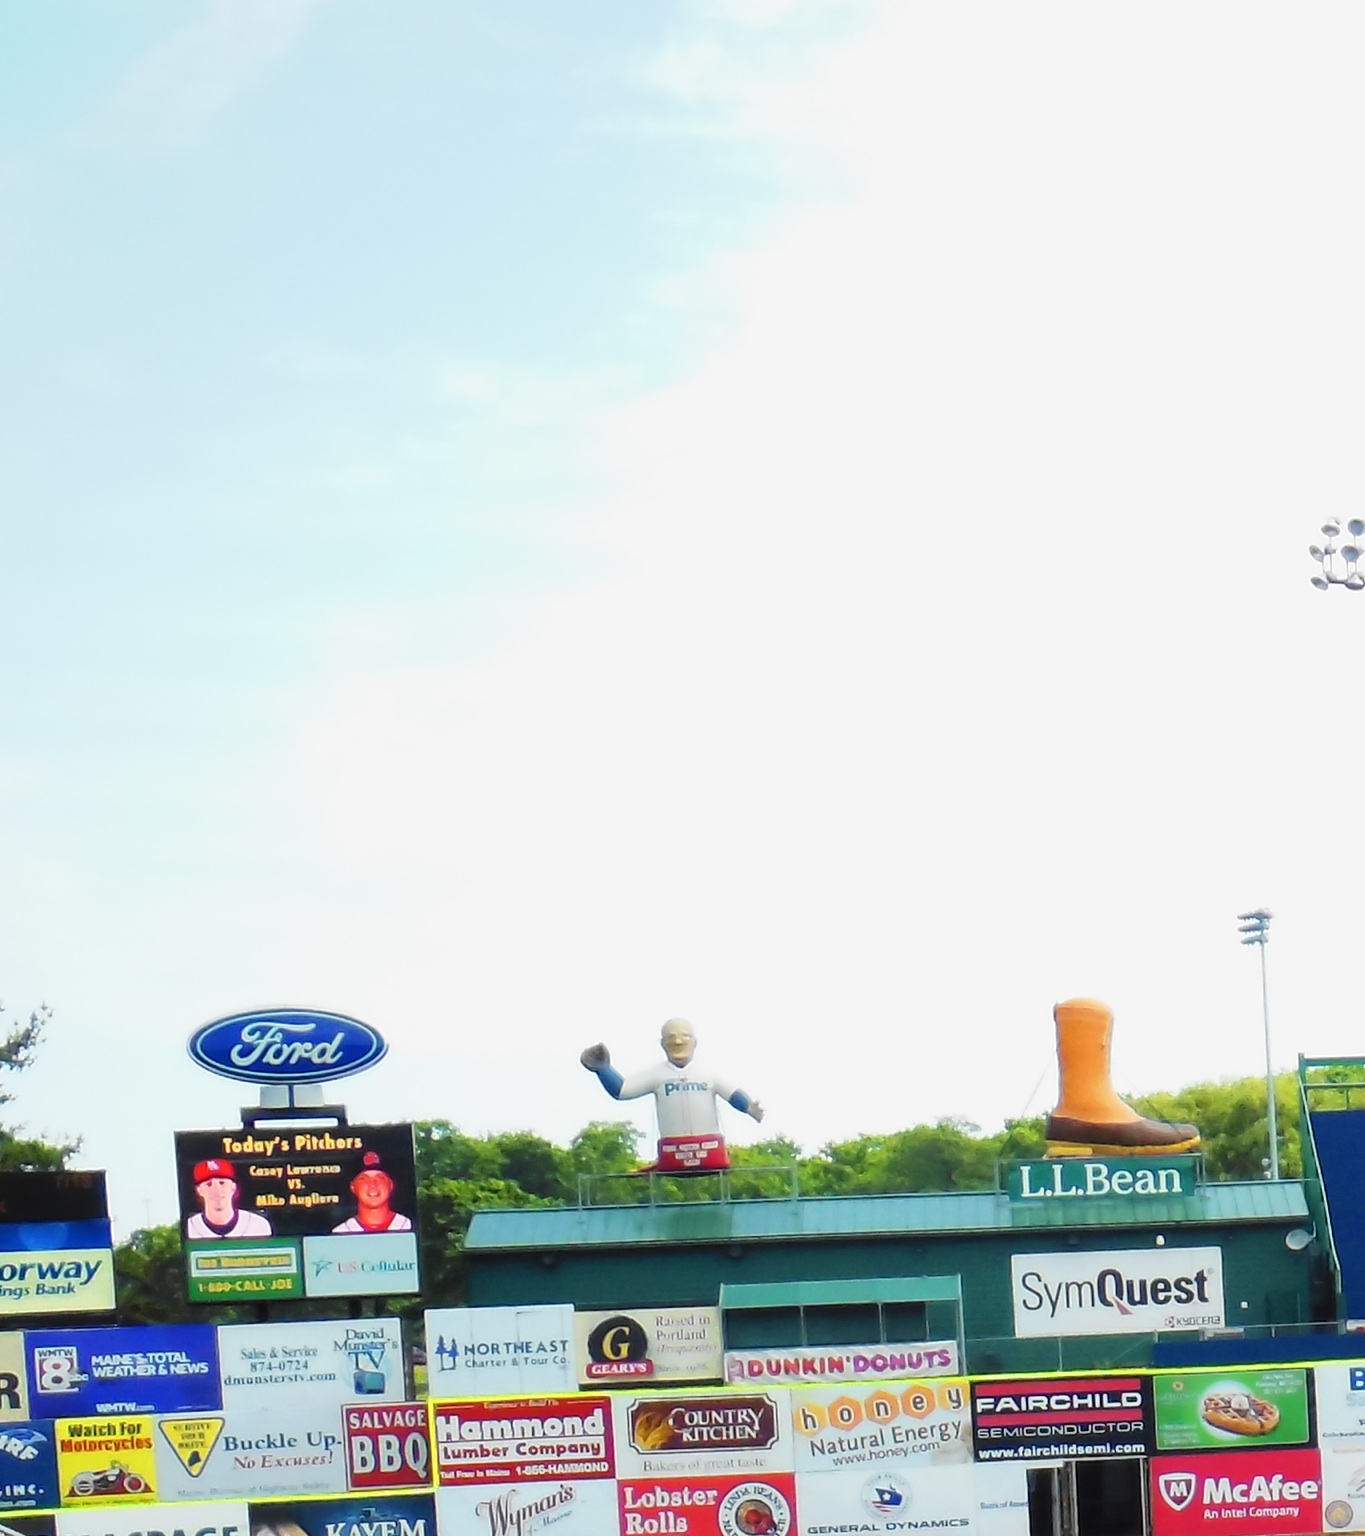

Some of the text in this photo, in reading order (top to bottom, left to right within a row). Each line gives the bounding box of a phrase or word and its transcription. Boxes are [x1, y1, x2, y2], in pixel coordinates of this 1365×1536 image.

[230, 1021, 345, 1066] Ford
[665, 1080, 708, 1096] prime
[222, 1136, 290, 1156] Today's
[35, 1282, 76, 1296] Bank
[1022, 1268, 1209, 1317] SymQuest
[345, 1327, 384, 1340] David
[602, 1325, 630, 1361] G
[149, 1352, 191, 1364] TOTAL
[348, 1351, 385, 1371] TV
[465, 1358, 507, 1369] Charter
[523, 1356, 548, 1367] Tour
[747, 1349, 952, 1377] DUNKIN' DONUTS
[92, 1362, 209, 1378] WEATHER & NEWS
[591, 1362, 647, 1375] GEARY'S
[977, 1392, 1142, 1414] FAIRCHILD
[349, 1409, 427, 1430] SALVAGE
[436, 1408, 605, 1441] Hammond
[68, 1421, 142, 1437] Watch For
[682, 1425, 757, 1442] KITCHEN
[809, 1420, 962, 1456] Natural Energy
[978, 1421, 1143, 1439] SEMICONDUCTOR
[60, 1437, 153, 1453] Motorcycles
[224, 1433, 298, 1451] Buckle
[443, 1442, 600, 1459] Lumber Company
[979, 1442, 1145, 1459] www.fairchildsemi.com
[234, 1452, 333, 1470] No Excuses!
[353, 1431, 429, 1479] BBQ
[1170, 1480, 1187, 1497] M
[1202, 1474, 1319, 1505] McAfee
[623, 1487, 718, 1509] Lobster
[1204, 1506, 1300, 1519] An Intel Company
[625, 1511, 688, 1535] Rolls
[808, 1518, 970, 1535] GENERAL DYNAMICS
